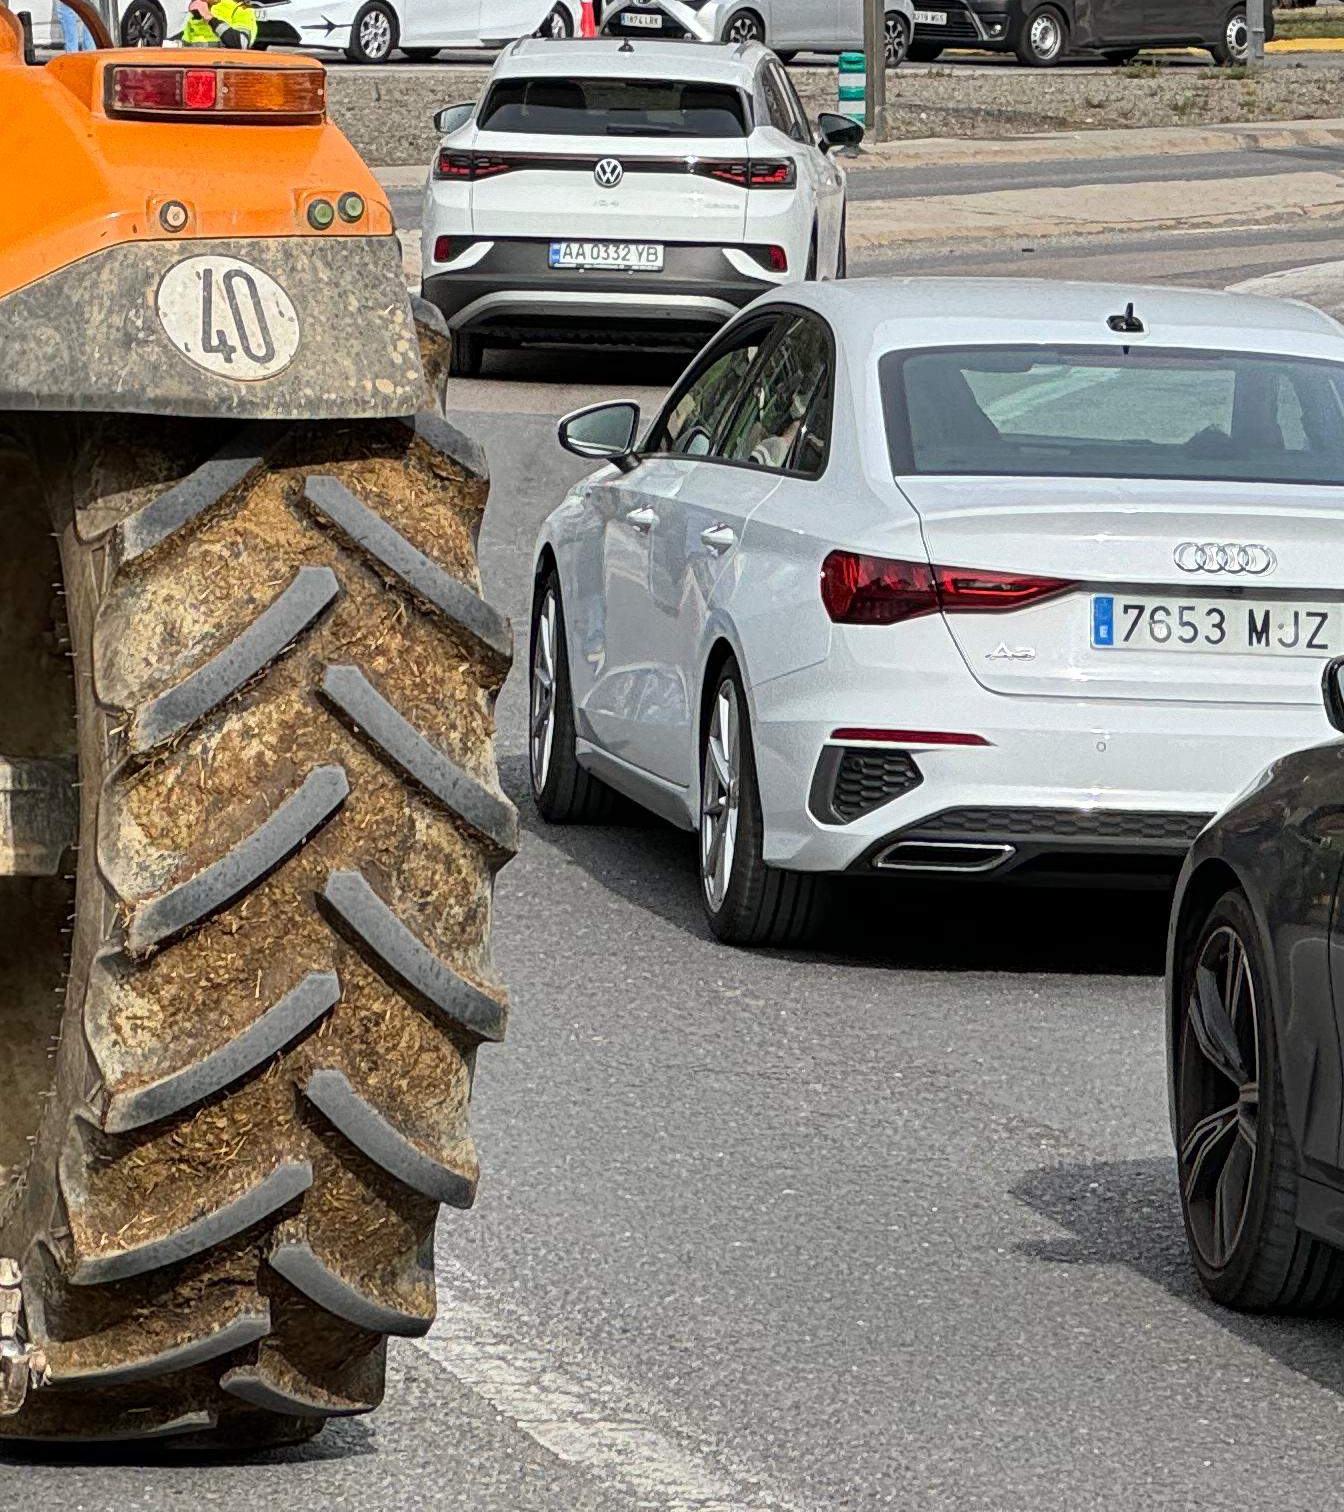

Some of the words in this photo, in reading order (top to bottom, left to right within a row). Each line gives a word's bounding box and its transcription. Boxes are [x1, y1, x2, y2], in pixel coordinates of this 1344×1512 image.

[590, 243, 631, 262] 0332
[201, 268, 276, 364] 40
[1122, 604, 1226, 645] 7653
